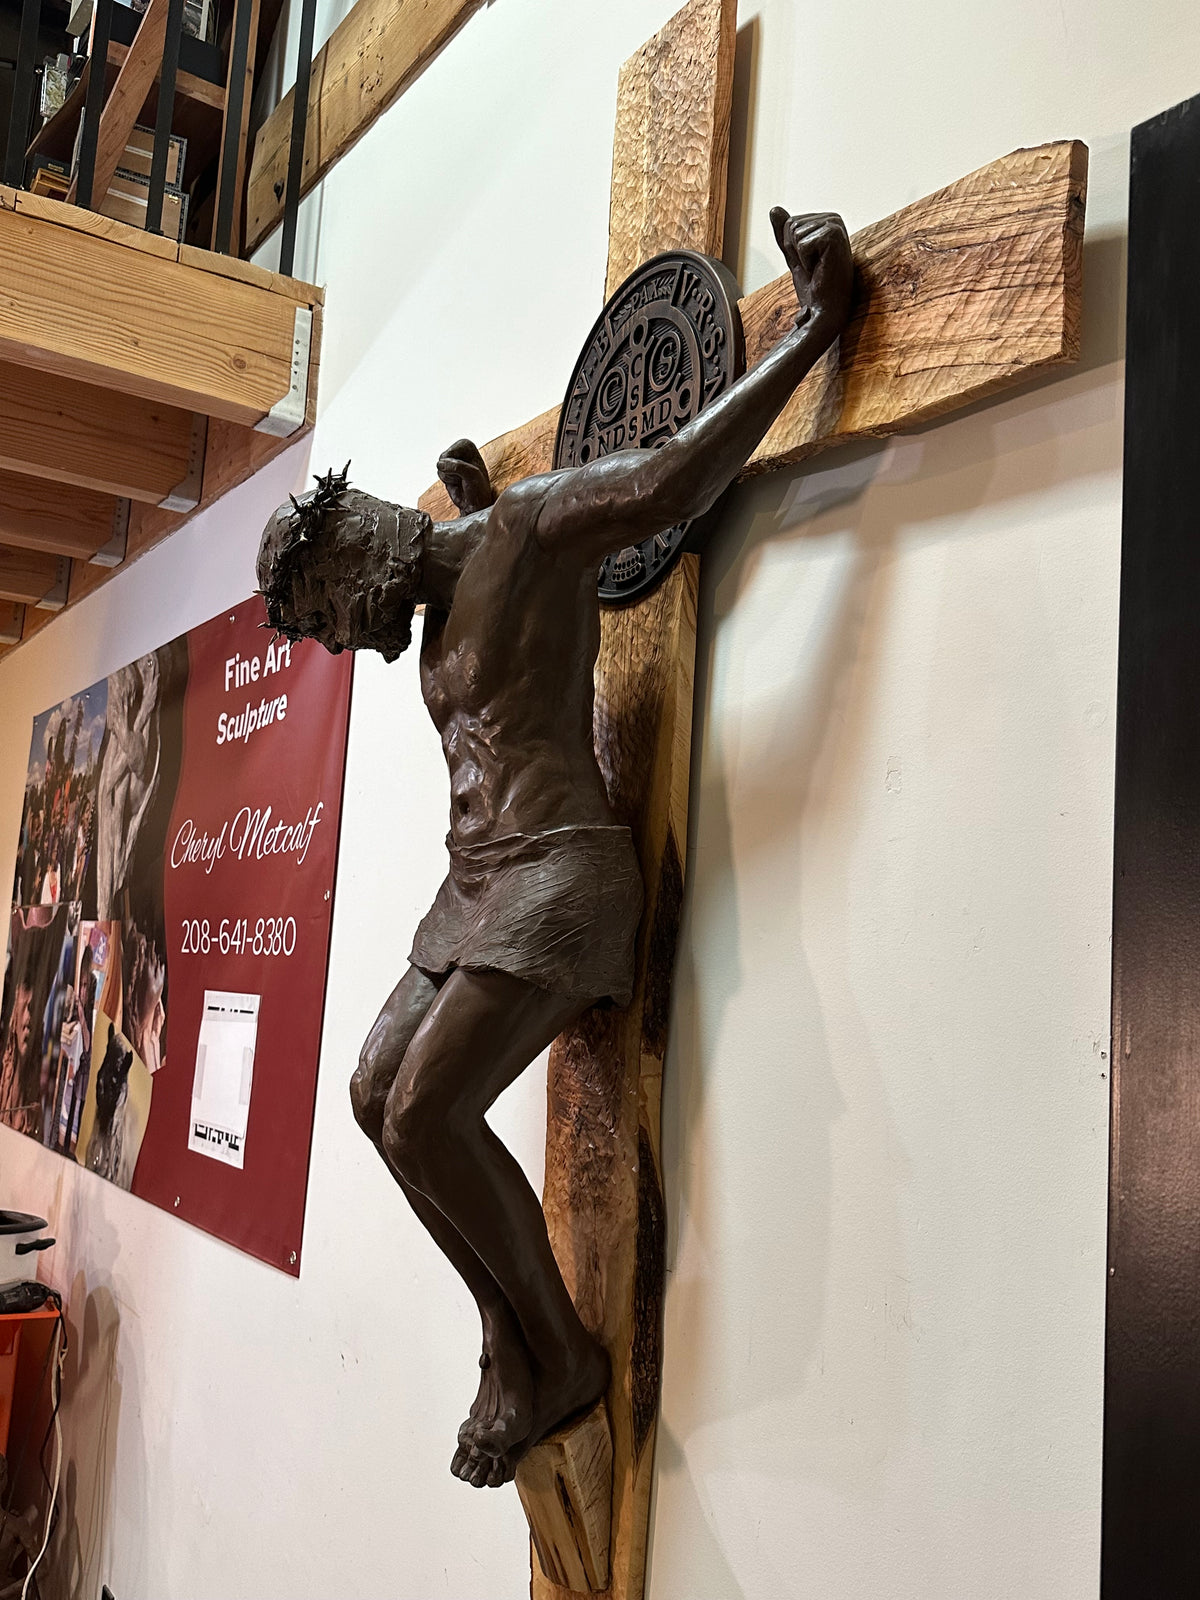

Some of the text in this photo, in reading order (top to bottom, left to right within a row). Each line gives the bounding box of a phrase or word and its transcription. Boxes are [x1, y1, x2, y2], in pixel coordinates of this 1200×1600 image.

[225, 639, 291, 692] Fine Art
[216, 694, 288, 745] Sculpture
[170, 802, 324, 874] Cheryl Metcalf
[181, 916, 297, 956] 208-641-8380
